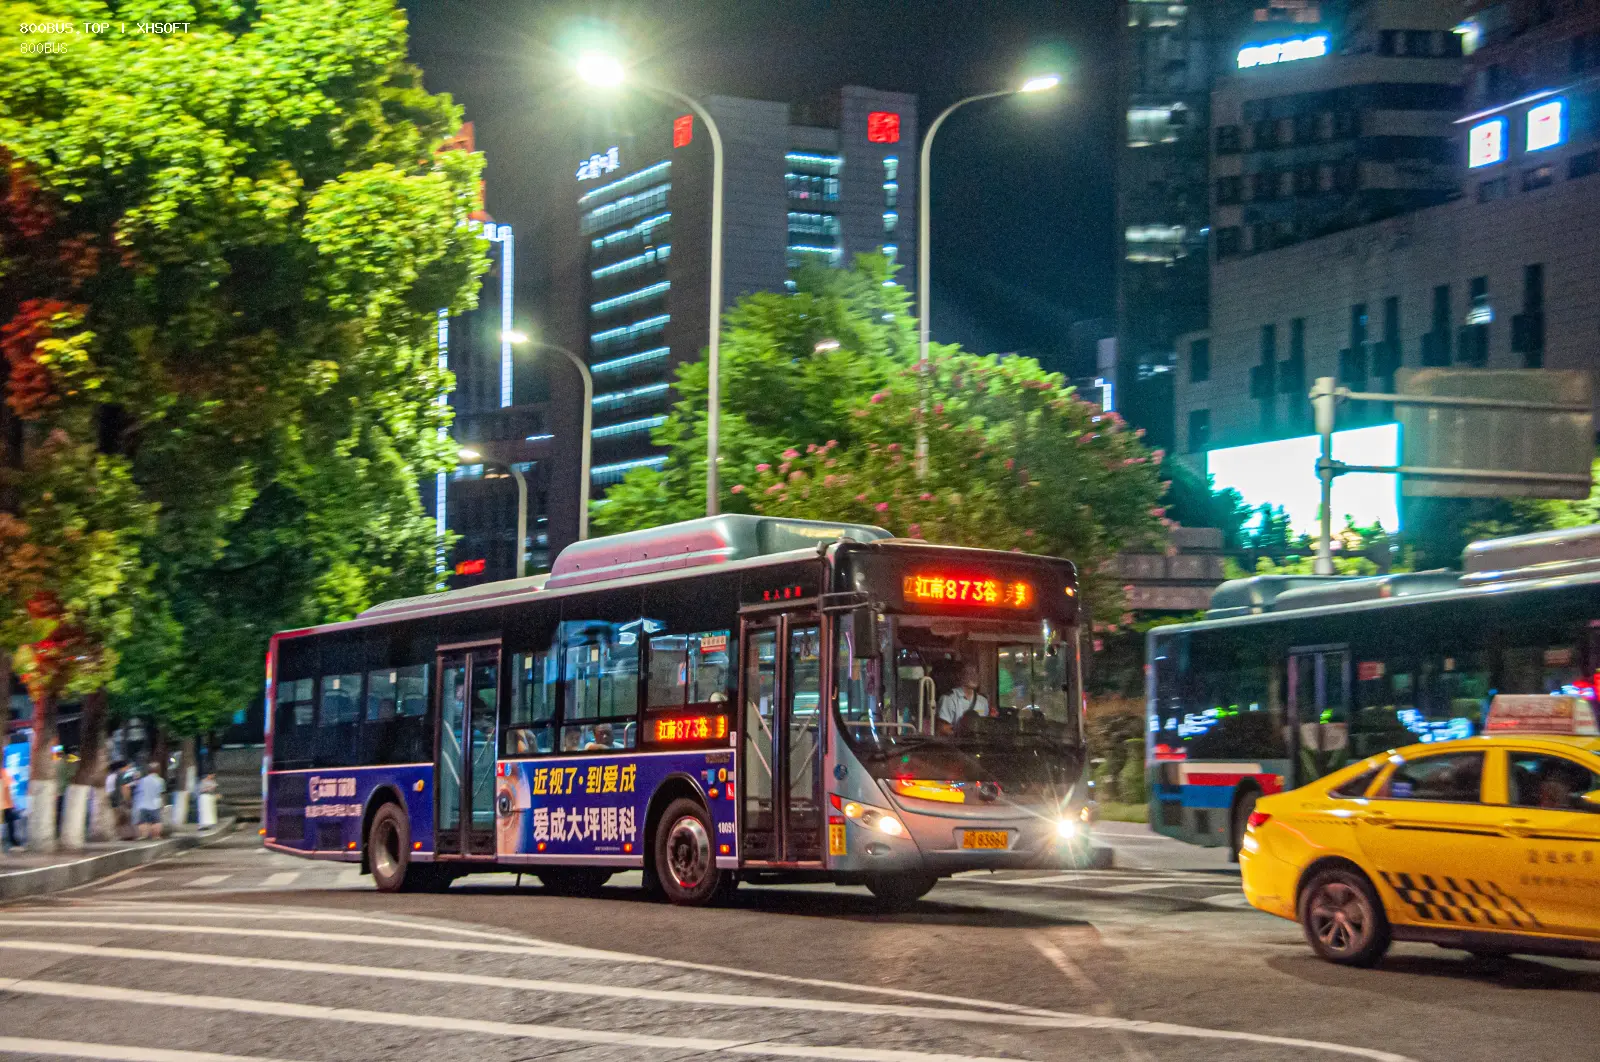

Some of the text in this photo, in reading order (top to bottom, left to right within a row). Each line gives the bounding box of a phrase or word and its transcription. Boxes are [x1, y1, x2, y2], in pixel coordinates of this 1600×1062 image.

[533, 806, 637, 842] 爱成大坪眼科
